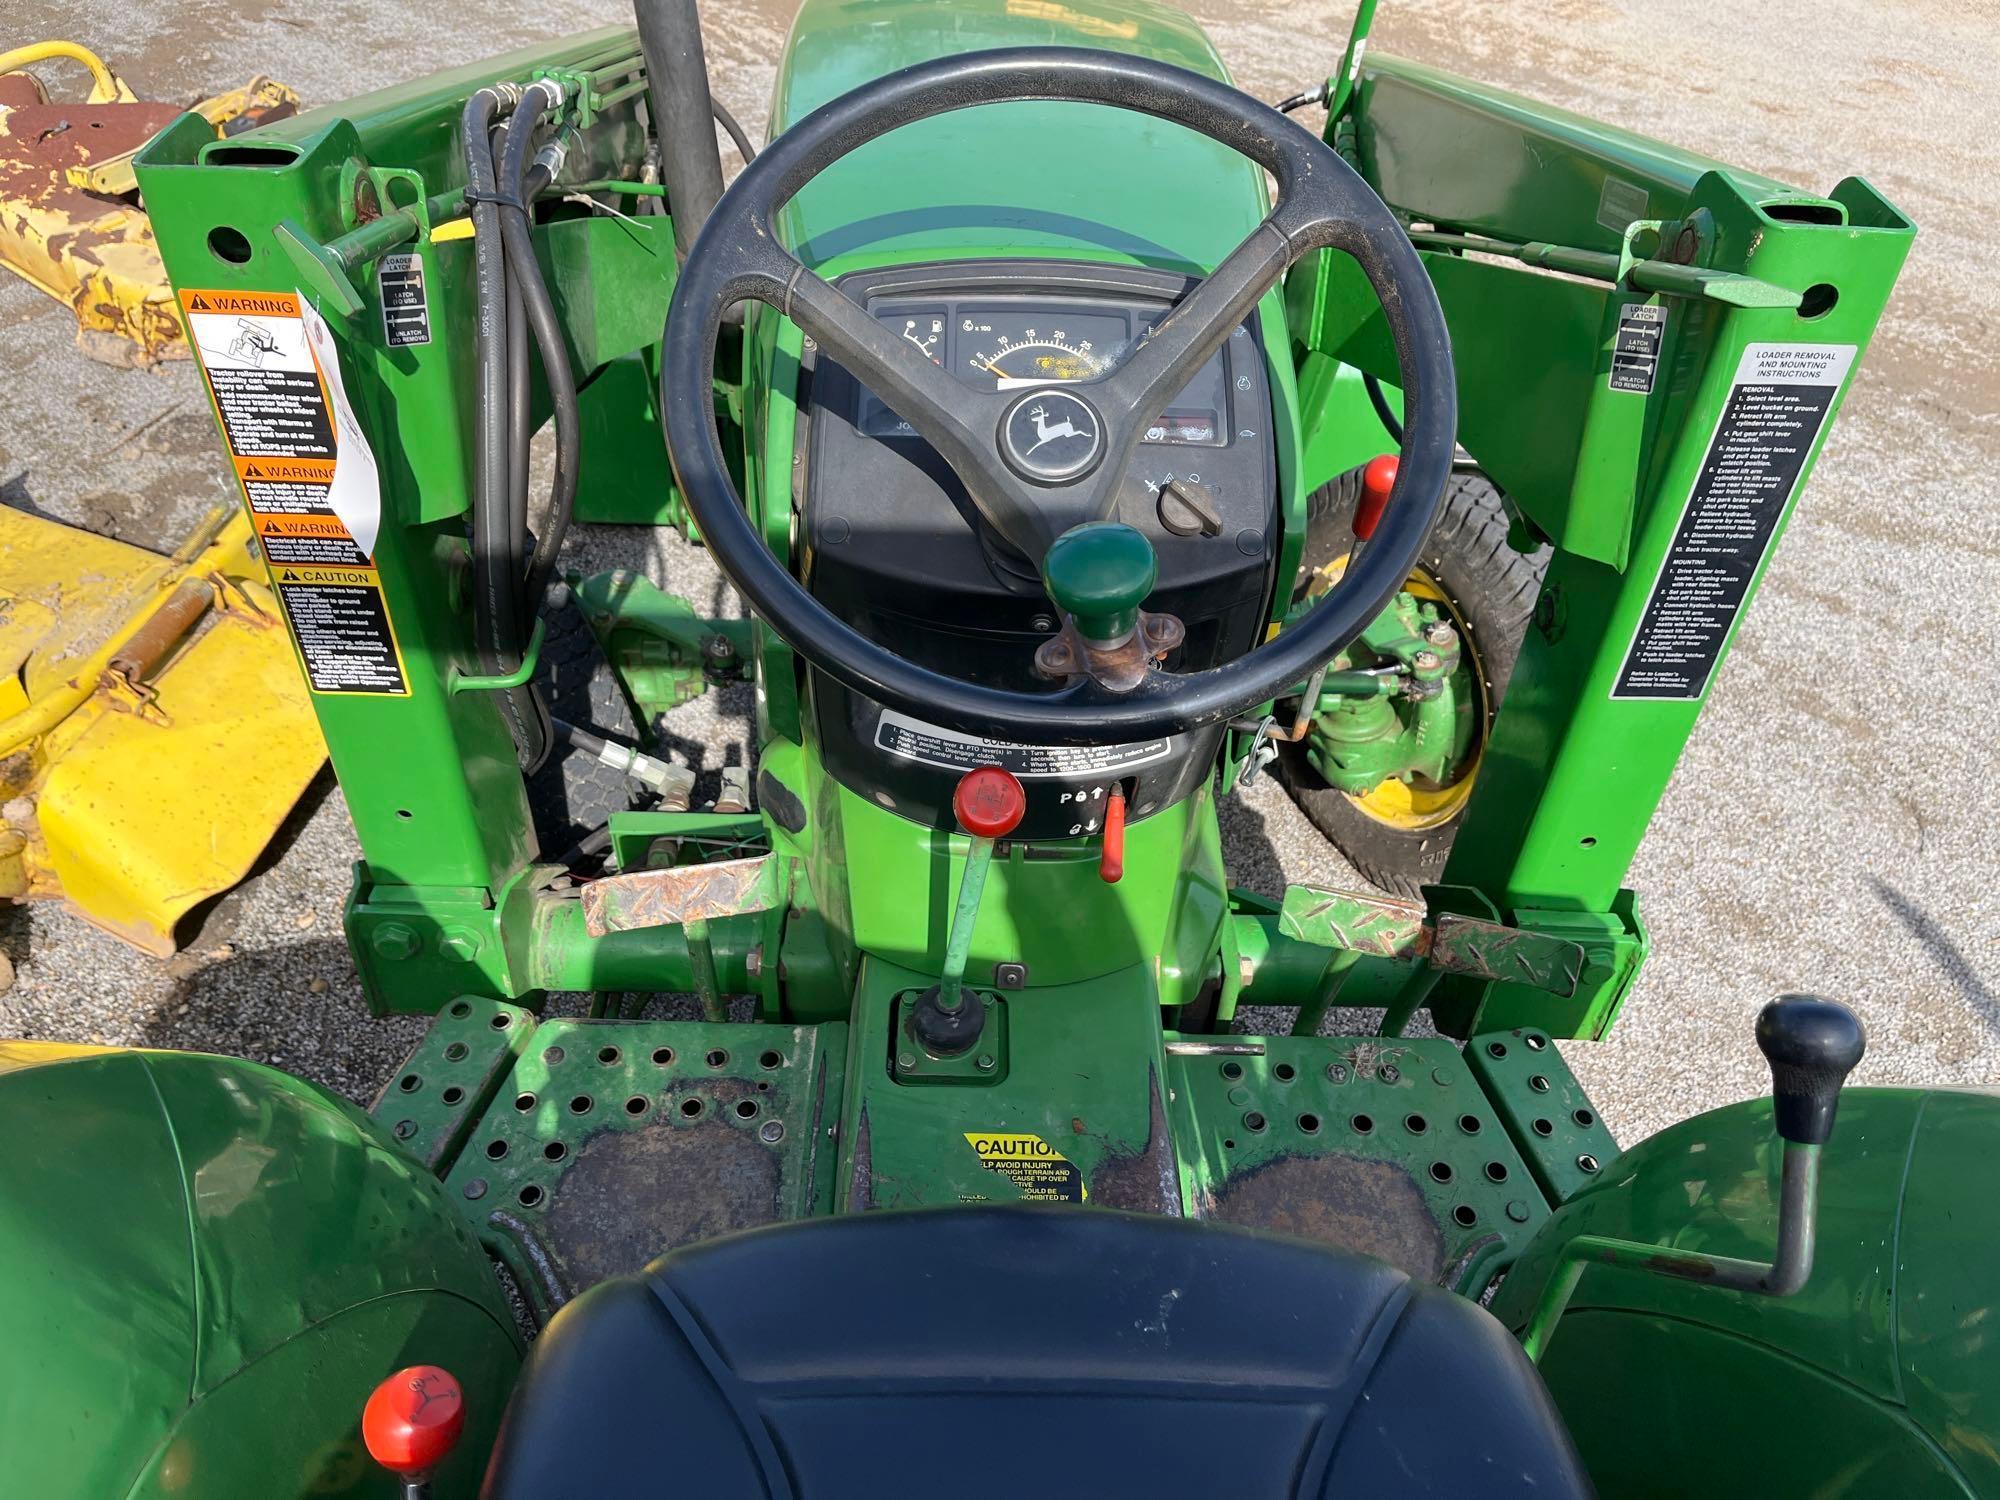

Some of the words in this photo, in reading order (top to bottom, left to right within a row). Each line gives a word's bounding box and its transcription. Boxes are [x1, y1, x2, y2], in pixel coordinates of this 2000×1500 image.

[214, 298, 294, 313] WARNING
[998, 336, 1008, 345] 10
[1080, 340, 1092, 350] 25
[1794, 352, 1836, 360] REMOVAL
[284, 523, 349, 535] WARNIN
[303, 571, 368, 583] CAUTION
[900, 729, 915, 738] Place
[917, 736, 940, 745] gearshift
[897, 740, 910, 749] Push
[912, 745, 930, 753] speed
[972, 757, 1002, 766] completely
[919, 741, 941, 750] position.
[945, 747, 975, 757] Disengage
[1125, 749, 1143, 757] reduce
[1144, 743, 1161, 752] engine
[1060, 793, 1072, 803] P
